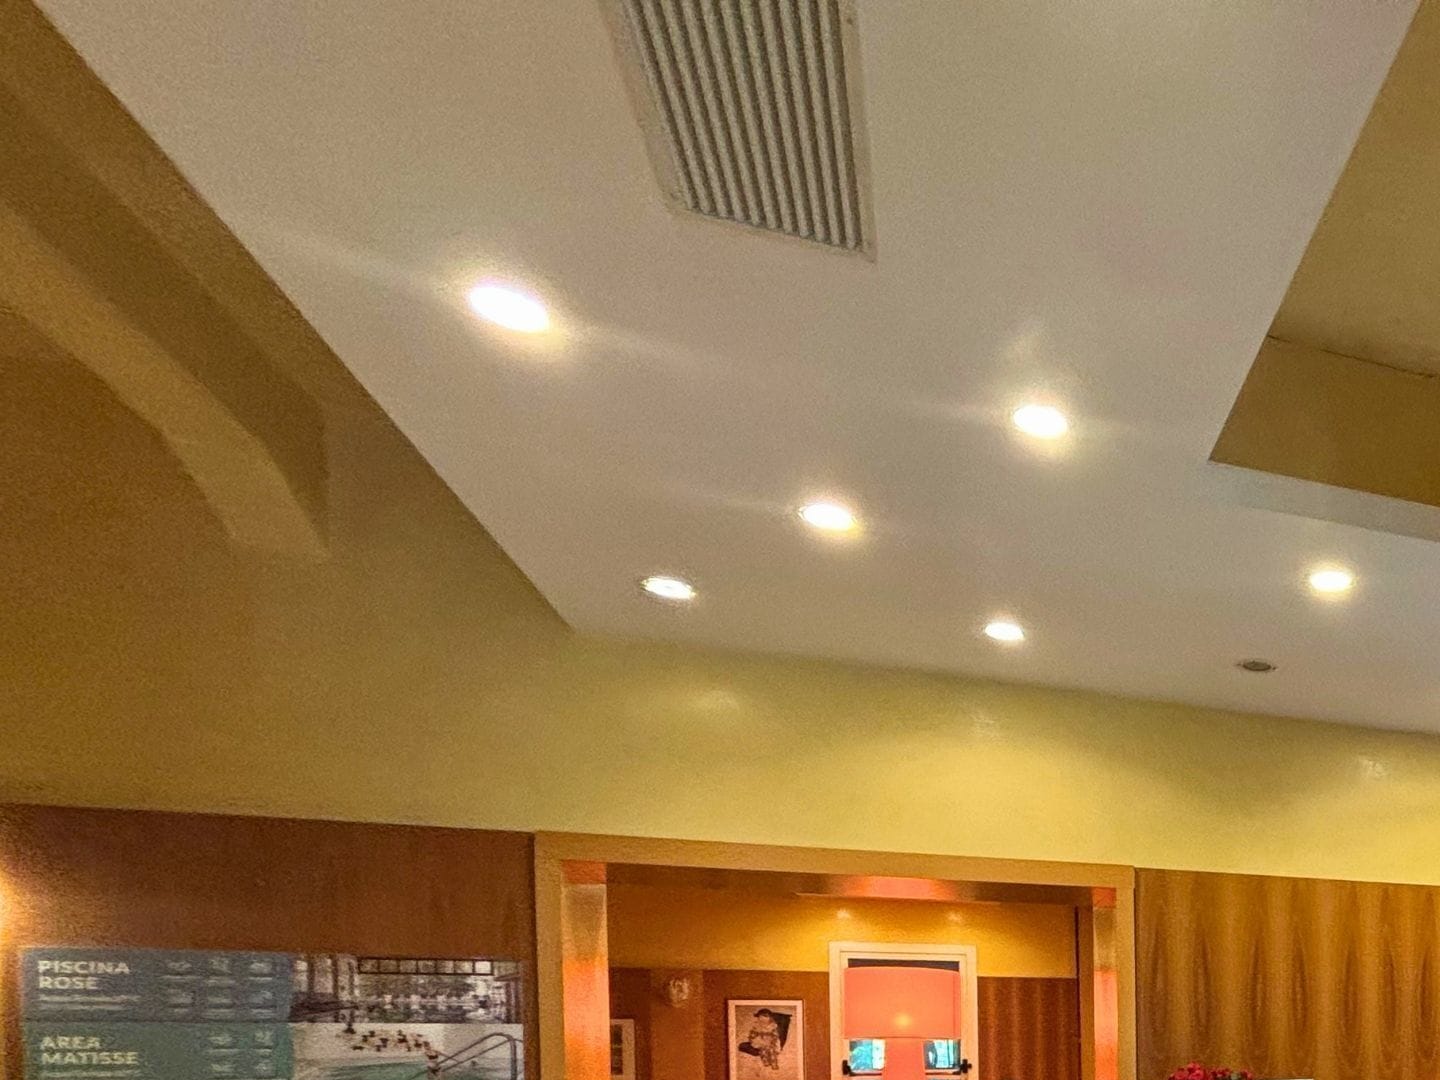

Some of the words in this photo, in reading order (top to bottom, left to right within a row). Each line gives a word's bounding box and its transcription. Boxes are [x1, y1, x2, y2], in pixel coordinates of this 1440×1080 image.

[38, 960, 130, 974] PISCINA
[38, 976, 99, 990] ROSE
[41, 1036, 101, 1049] AREA
[42, 1051, 139, 1065] MATISSE
